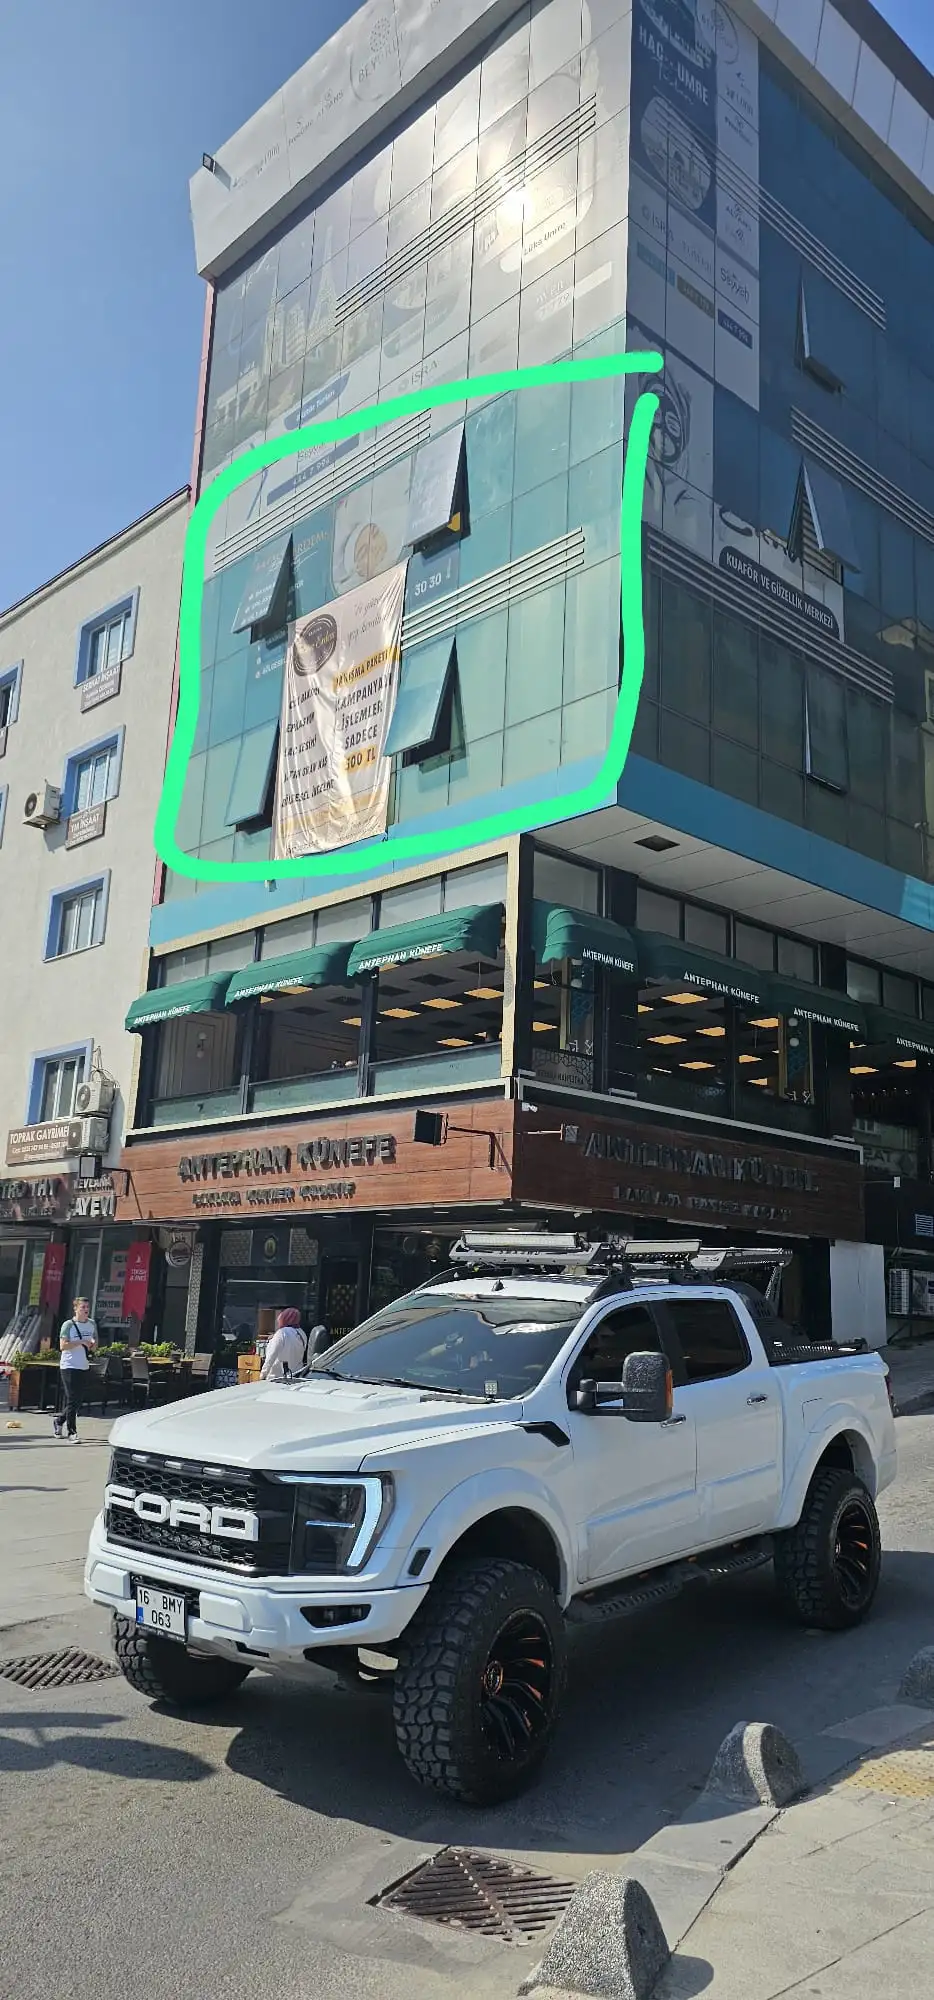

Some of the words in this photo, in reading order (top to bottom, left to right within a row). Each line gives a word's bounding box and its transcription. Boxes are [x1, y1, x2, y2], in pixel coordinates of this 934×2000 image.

[678, 60, 708, 106] UMRE
[429, 571, 442, 588] 30
[726, 552, 759, 583] KUAFÖR
[760, 574, 770, 590] VE
[771, 580, 803, 611] GÜZELLİK
[804, 602, 833, 629] MERKEZİ
[341, 699, 383, 732] İŞLEMLER
[345, 724, 378, 750] SADECE
[367, 747, 376, 762] TL
[358, 951, 407, 970] ANTEPHAN
[408, 943, 444, 958] KÜNEFE
[582, 948, 614, 966] ANTEPHAN
[614, 957, 635, 973] KÜNEFE
[233, 982, 274, 998] ANTEPHAN
[274, 975, 304, 992] KÜNEFE
[683, 971, 729, 994] ANTEPHAN
[730, 987, 760, 1004] KÜNEFE
[133, 1010, 167, 1025] ANTEPHAN
[168, 1004, 192, 1016] KÜNEFE
[793, 1007, 832, 1025] ANTEPHAN
[834, 1018, 860, 1032] KÜNEFE
[896, 1037, 929, 1054] ANTEPHAN
[10, 1131, 35, 1145] TOPRAK
[178, 1144, 291, 1182] ANTEPHAN
[297, 1133, 397, 1171] KÜNEFE
[105, 1483, 259, 1541] FORD
[139, 1589, 150, 1605] 16
[162, 1596, 183, 1615] BMY
[151, 1609, 171, 1628] 063
